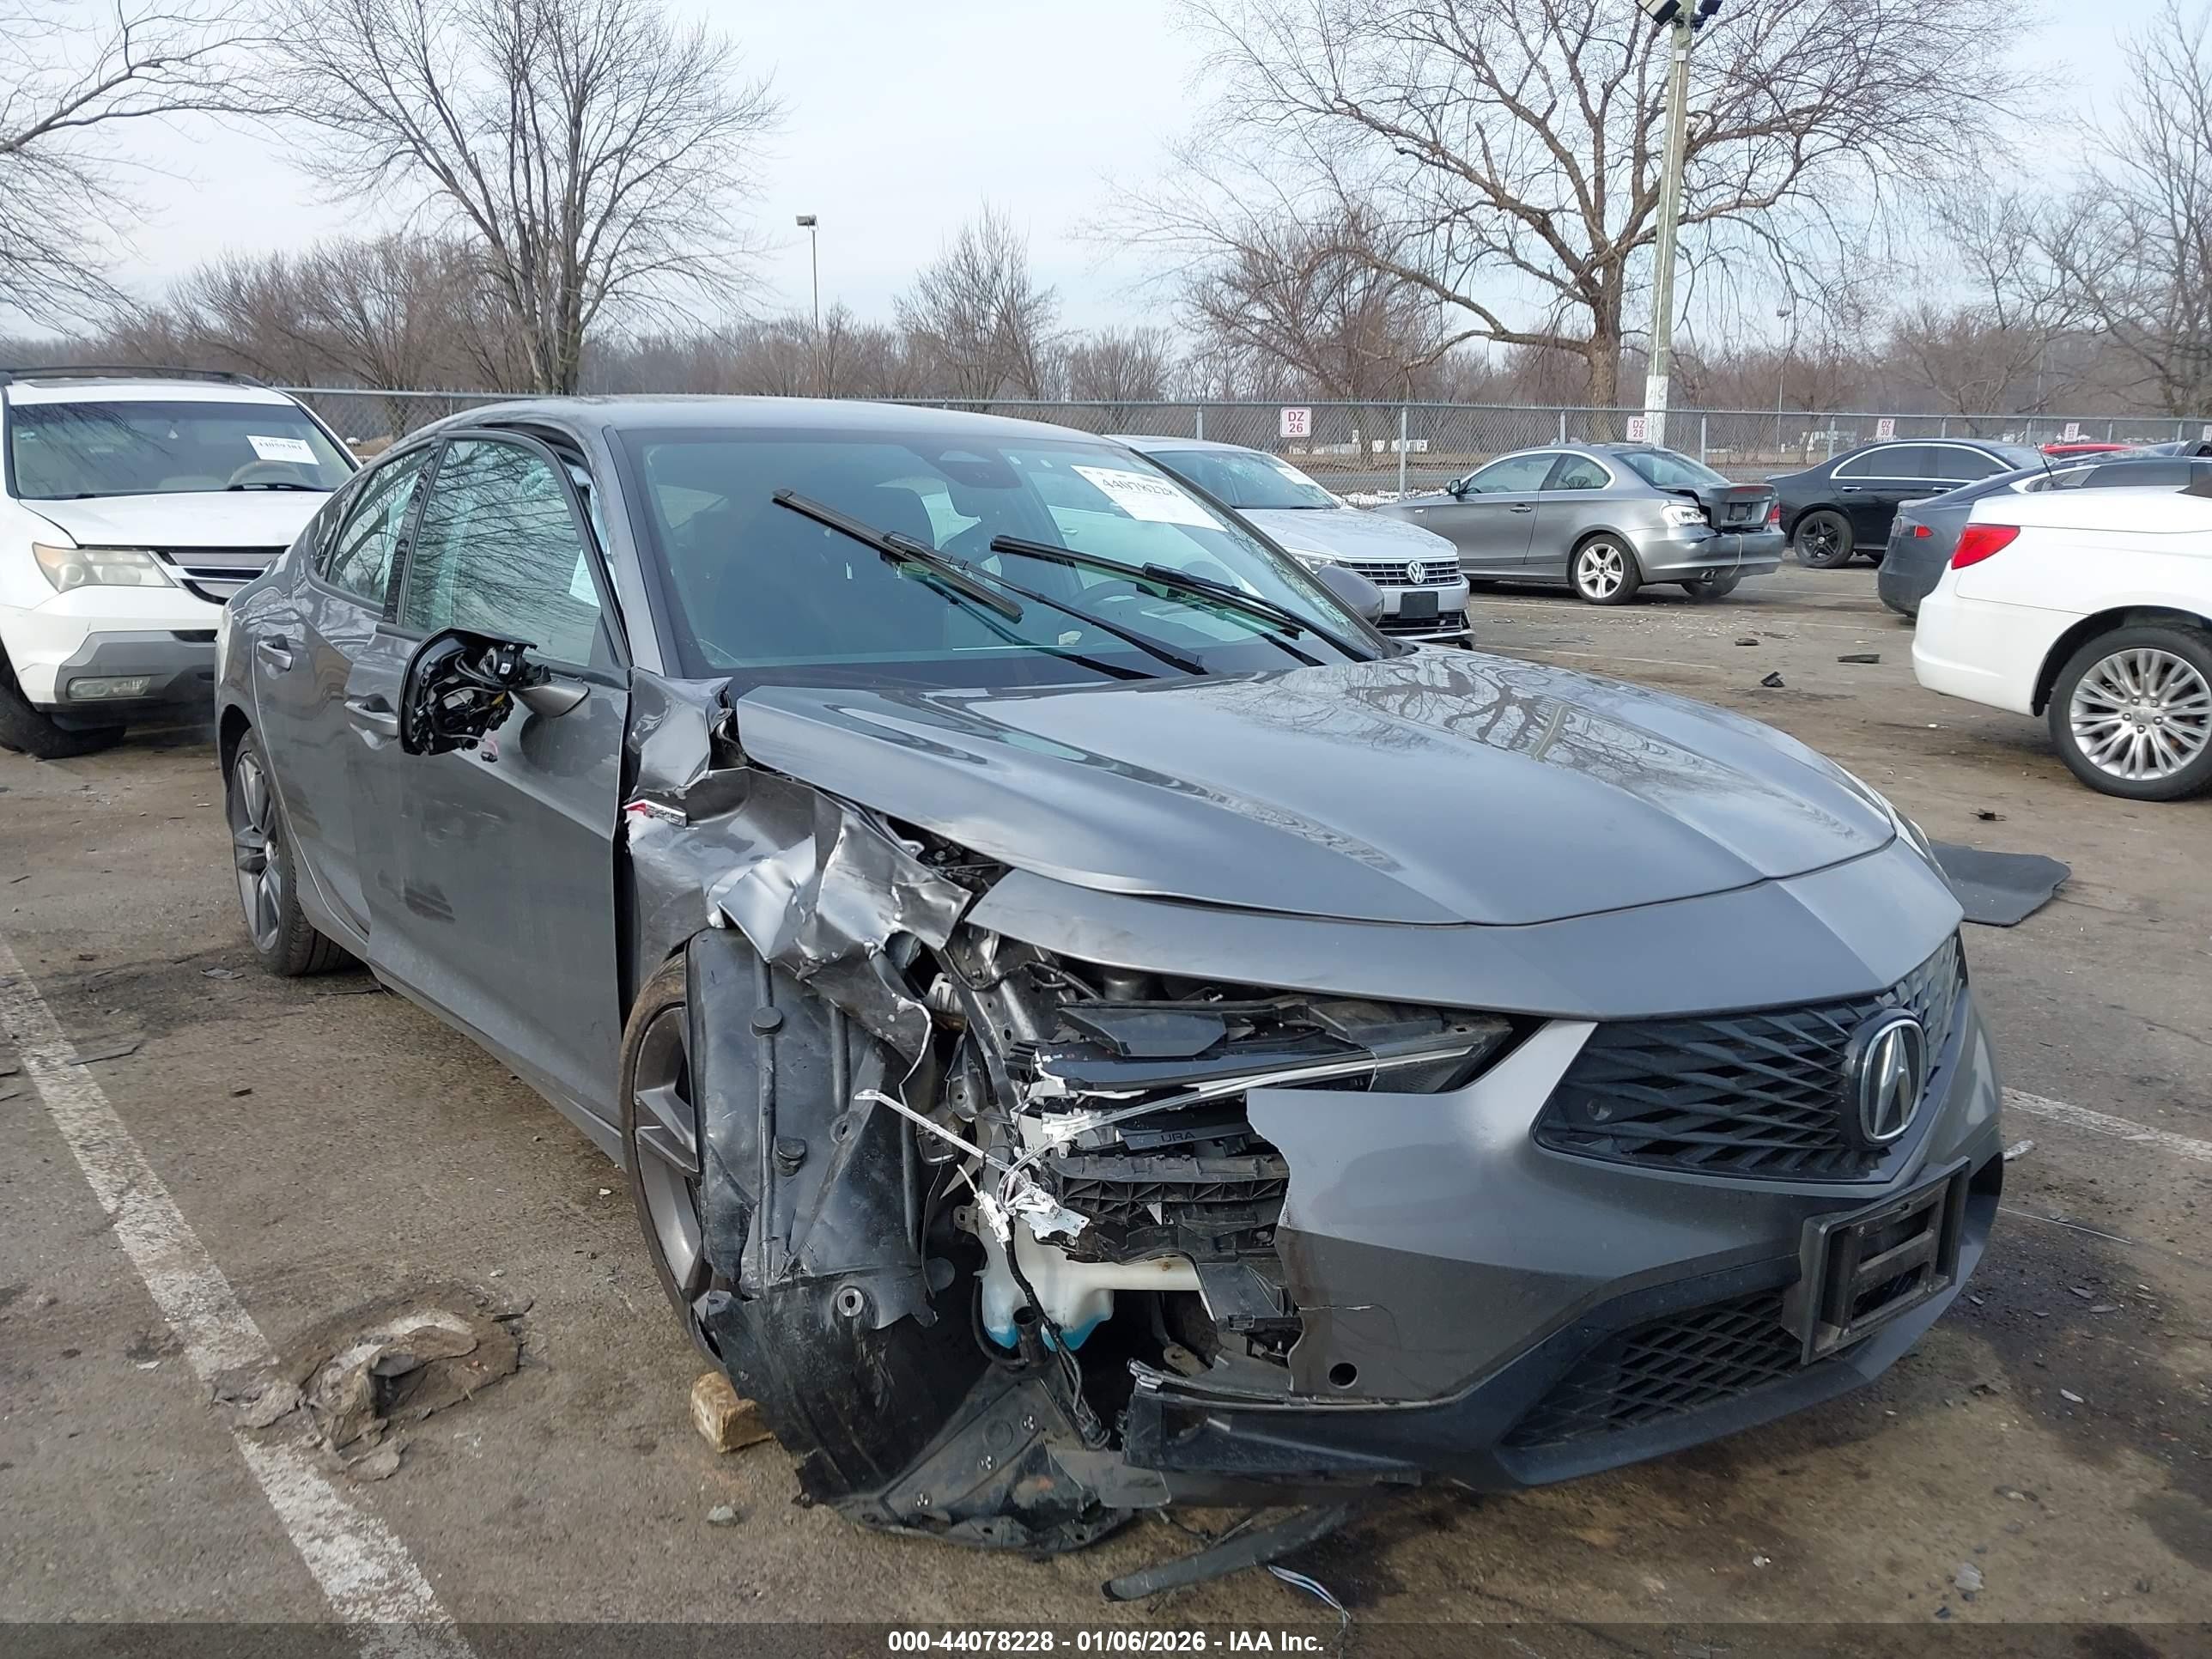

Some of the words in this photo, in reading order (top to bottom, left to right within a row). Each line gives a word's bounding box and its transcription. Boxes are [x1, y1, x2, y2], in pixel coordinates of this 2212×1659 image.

[1288, 411, 1304, 422] DZ
[1289, 422, 1304, 433] 26
[1632, 420, 1645, 428] DZ
[1633, 429, 1644, 438] 28
